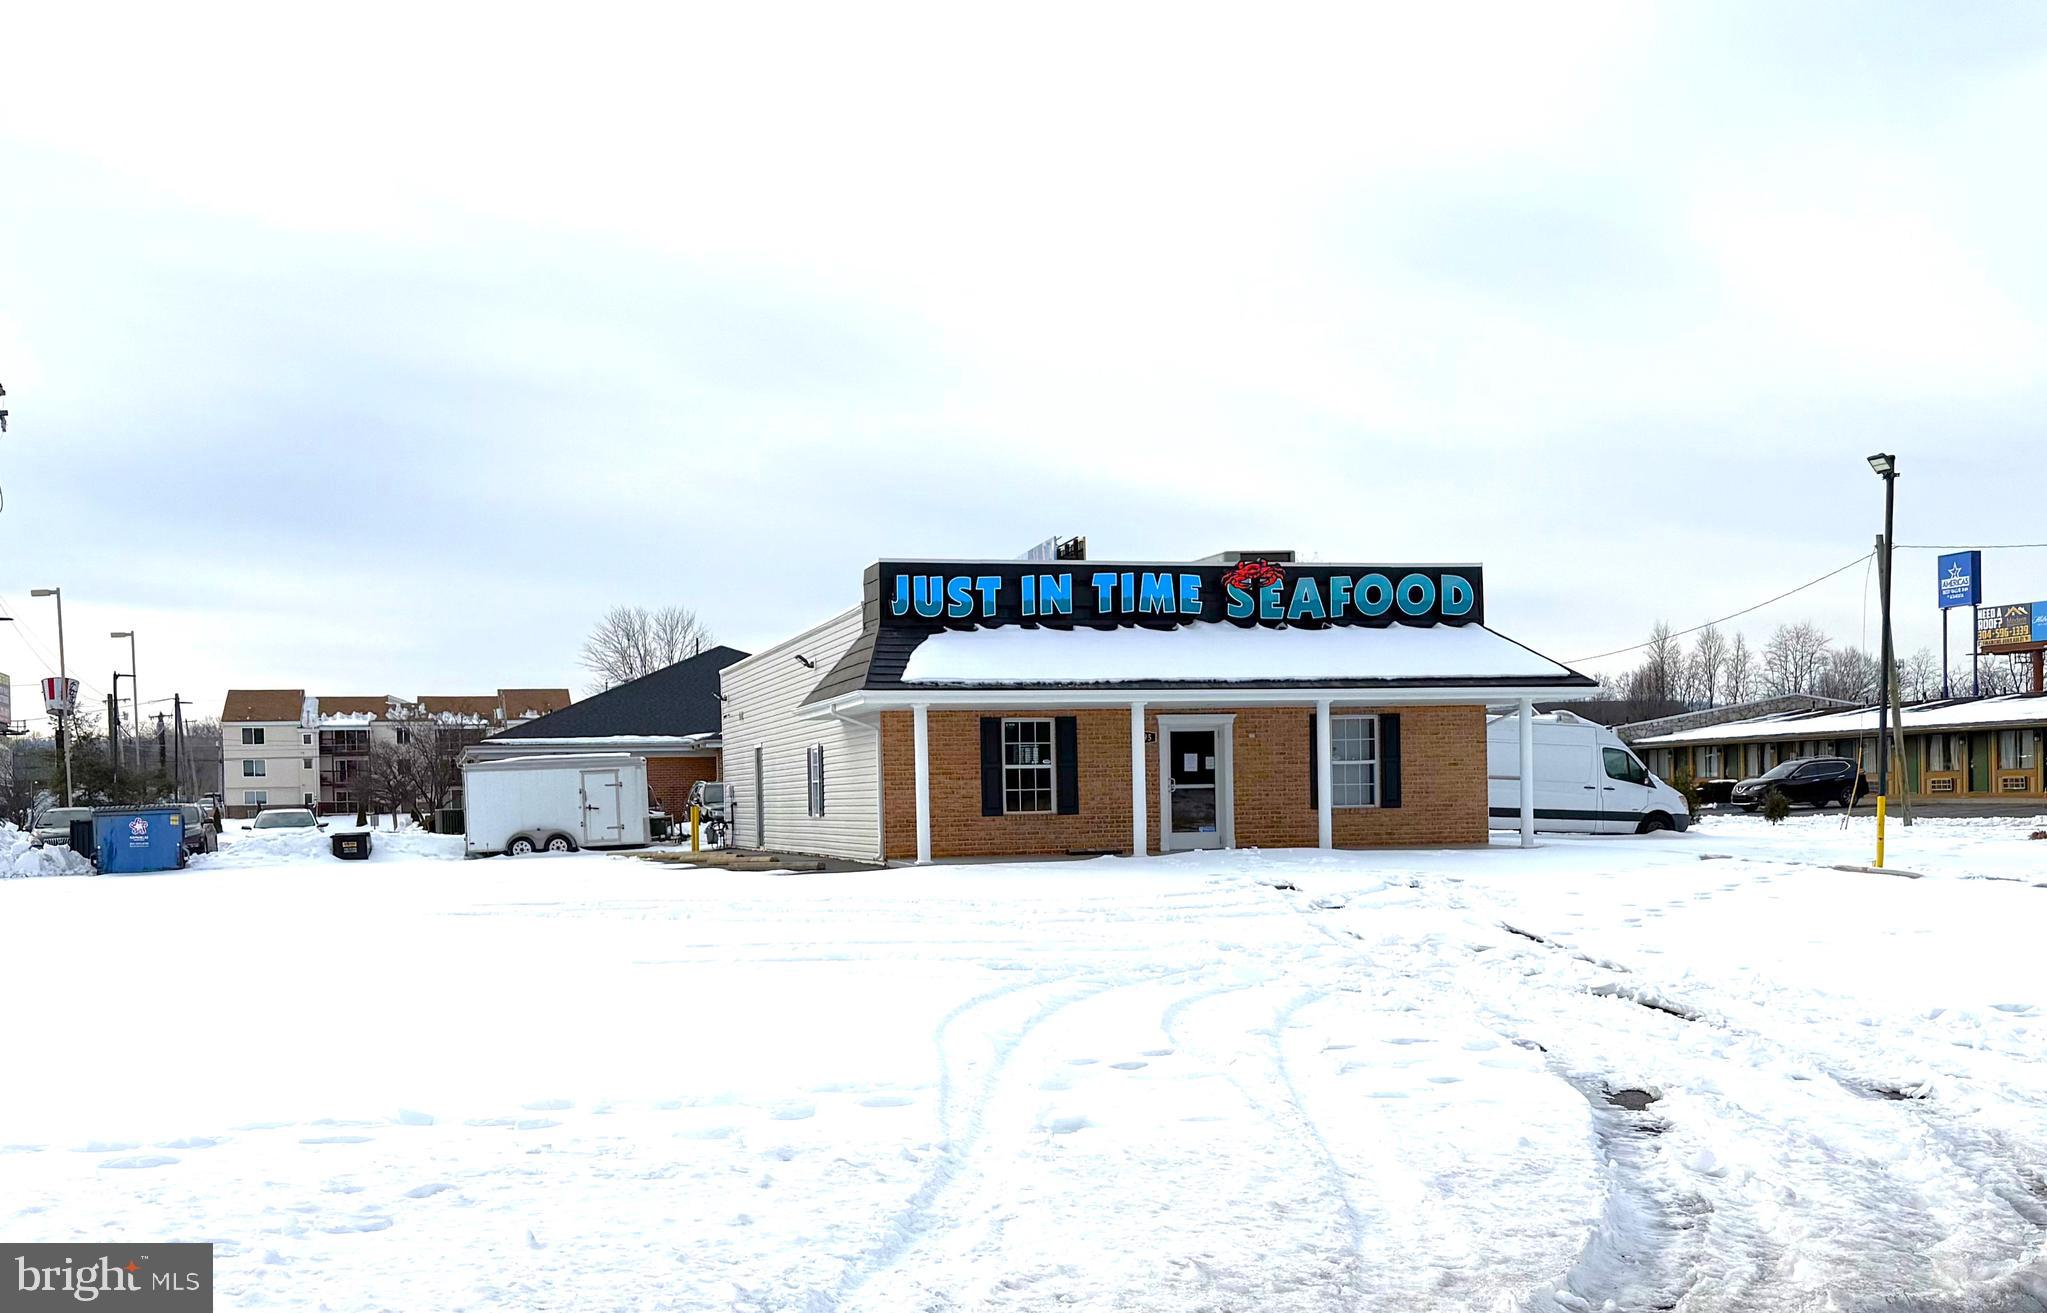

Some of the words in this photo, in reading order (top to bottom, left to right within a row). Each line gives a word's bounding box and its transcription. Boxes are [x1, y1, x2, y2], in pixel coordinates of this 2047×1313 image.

[891, 574, 1002, 618] JUST
[1021, 572, 1073, 617] IN
[1092, 572, 1202, 615] TIME
[1227, 573, 1474, 619] SEAFOOD
[1978, 608, 1996, 619] NEED
[1997, 607, 2002, 617] A
